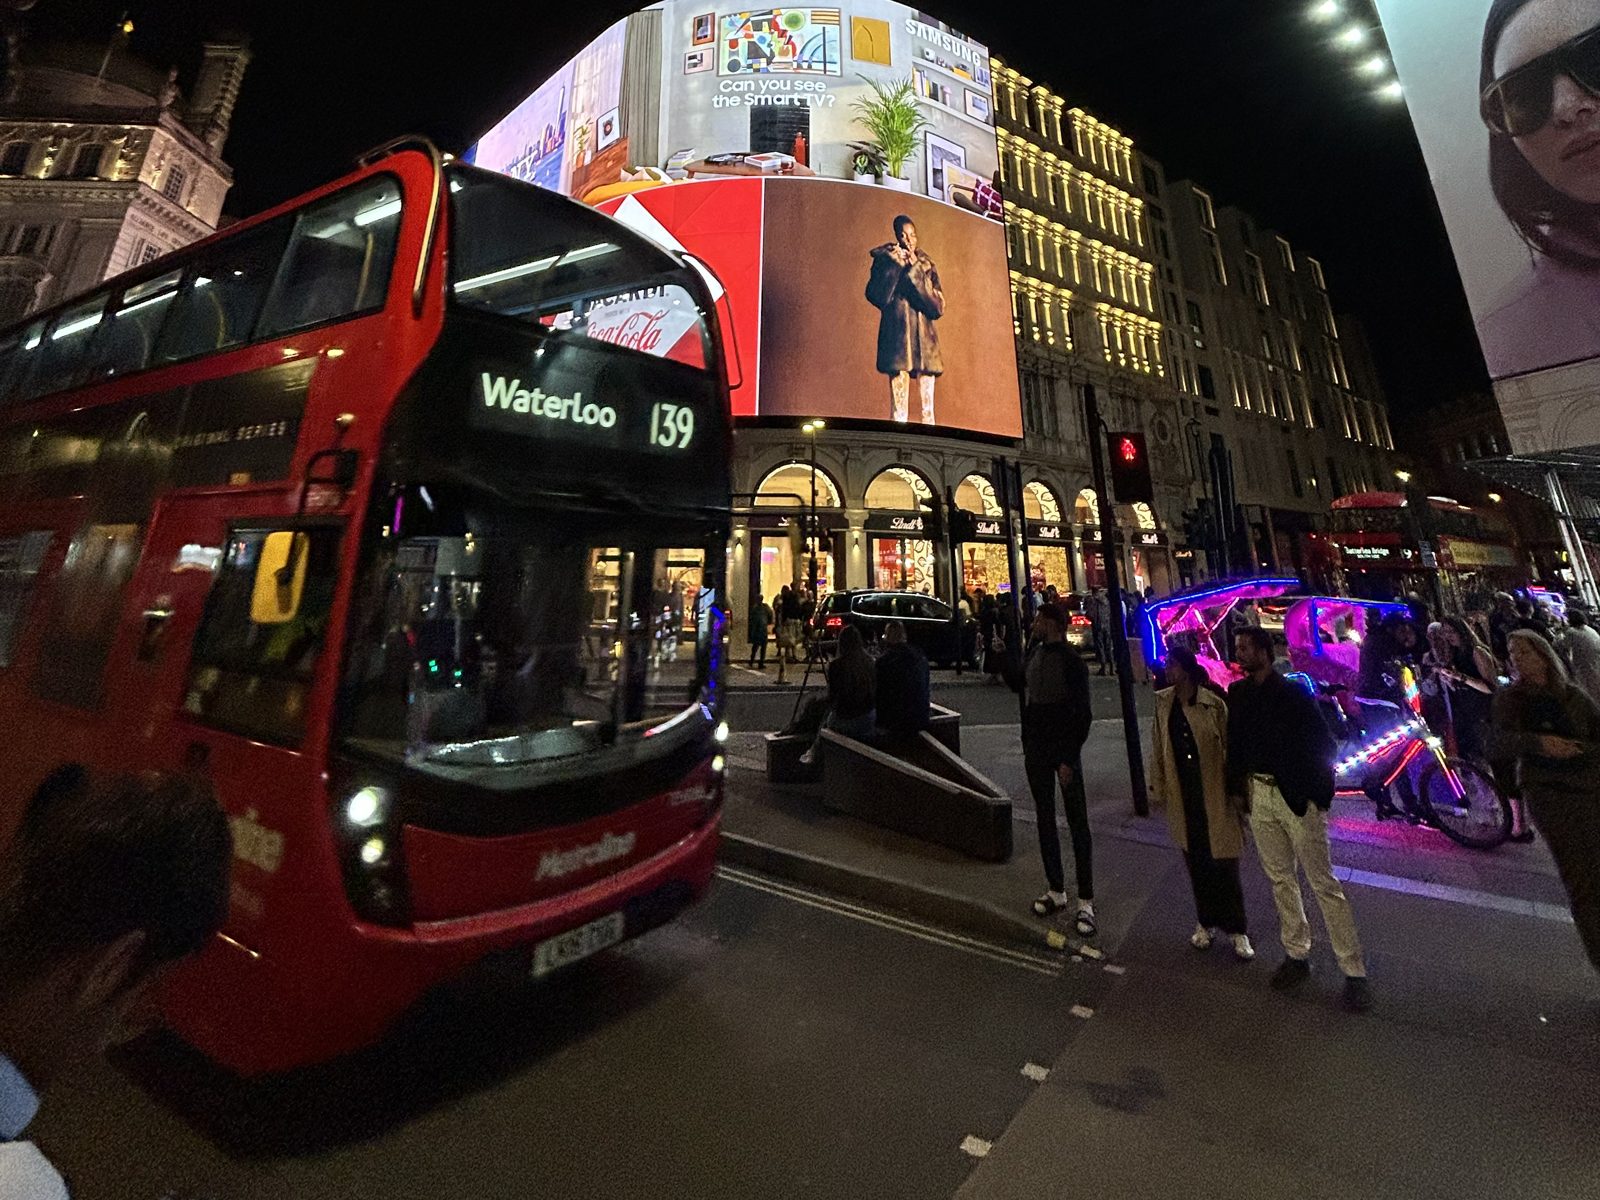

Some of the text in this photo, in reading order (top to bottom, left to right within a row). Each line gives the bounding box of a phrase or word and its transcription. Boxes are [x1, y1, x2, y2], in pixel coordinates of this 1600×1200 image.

[905, 18, 981, 67] SAMSUNG
[712, 93, 836, 108] the Smart TV?
[720, 80, 827, 94] Can you see
[481, 372, 694, 449] Waterloo 139
